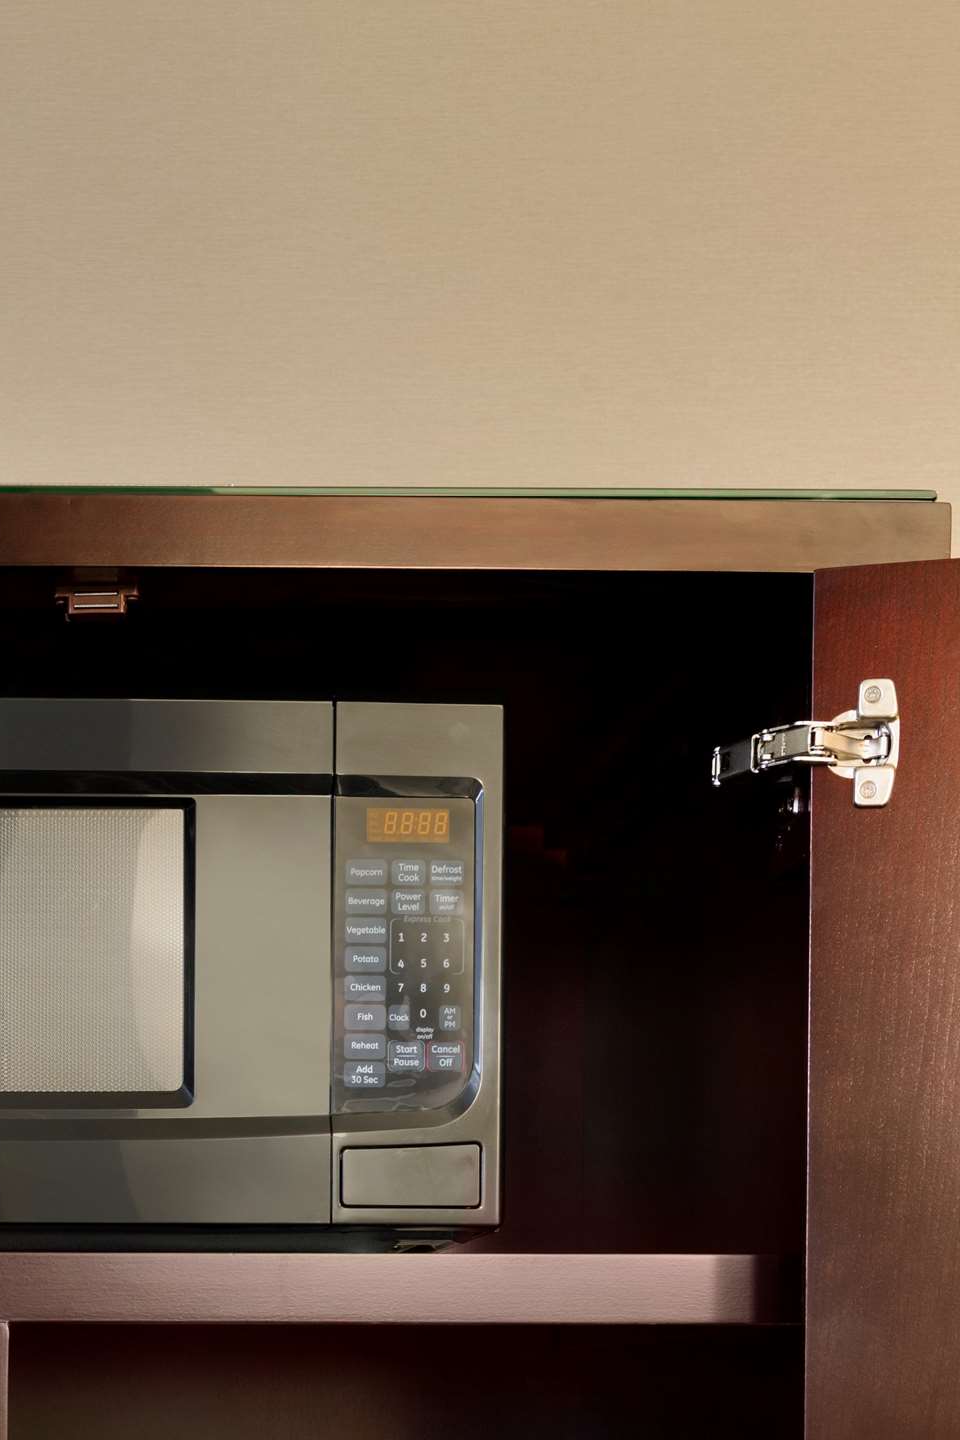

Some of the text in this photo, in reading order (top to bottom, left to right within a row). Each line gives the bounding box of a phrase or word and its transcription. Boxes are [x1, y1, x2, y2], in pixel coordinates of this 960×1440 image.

[398, 863, 419, 872] Time
[432, 865, 462, 874] Defrost
[350, 868, 383, 878] Popcorn
[398, 873, 420, 882] Cook
[395, 892, 422, 901] Power
[435, 894, 459, 903] Timer
[348, 897, 385, 907] Beverage
[398, 903, 420, 911] Level
[346, 926, 386, 936] Vegetable
[398, 933, 450, 942] 1 2 3
[352, 954, 379, 963] Potato
[398, 959, 450, 969] 4 5 6
[350, 983, 381, 992] Chicken
[398, 983, 450, 993] 7 8 9
[420, 1008, 427, 1018] 0
[444, 1007, 456, 1015] AM
[357, 1013, 373, 1021] Fish
[389, 1013, 409, 1022] Clock
[351, 1041, 379, 1050] Reheat
[396, 1045, 418, 1053] Start
[431, 1045, 460, 1054] Cancel
[393, 1058, 420, 1066] Pause
[439, 1058, 453, 1067] Off
[356, 1065, 373, 1074] Add
[351, 1075, 378, 1084] 30 Sec
